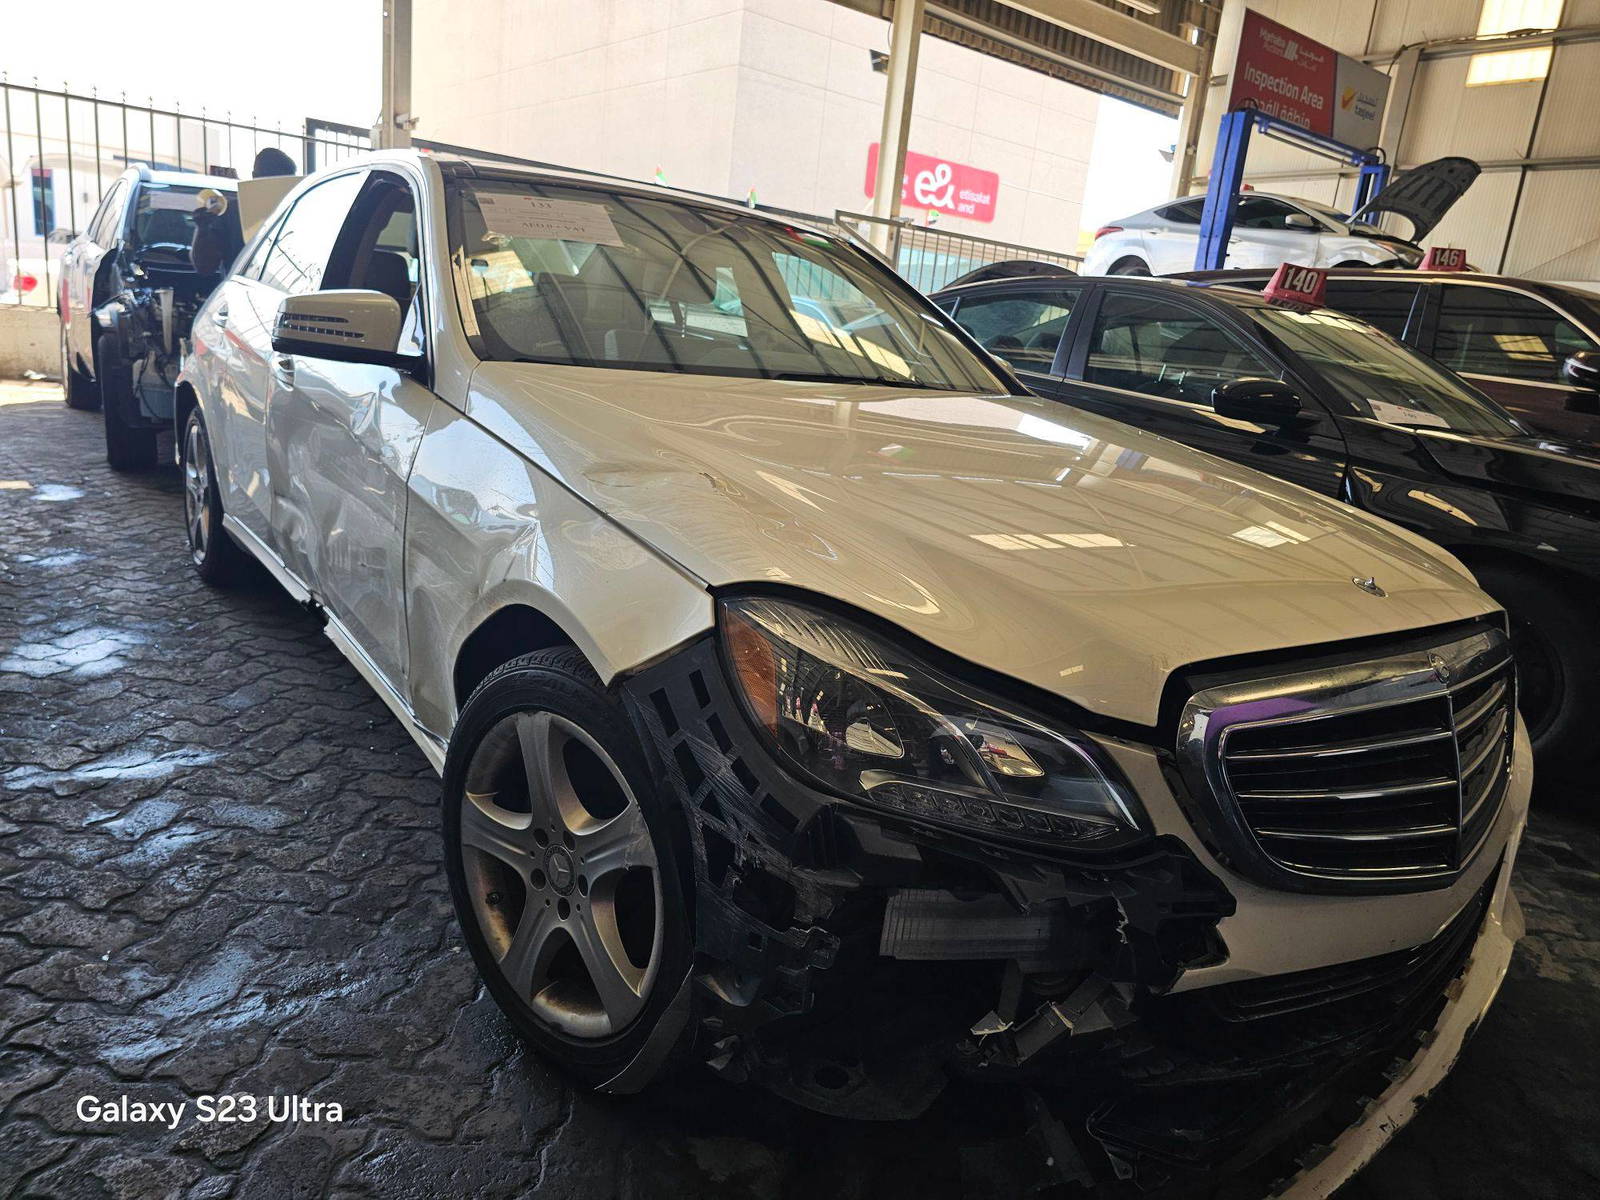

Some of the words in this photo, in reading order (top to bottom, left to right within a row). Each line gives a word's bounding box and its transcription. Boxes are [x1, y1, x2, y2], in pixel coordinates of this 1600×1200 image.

[1243, 61, 1299, 98] Inspection
[1299, 86, 1324, 110] Area
[1434, 250, 1459, 266] 146
[1284, 267, 1318, 294] 140
